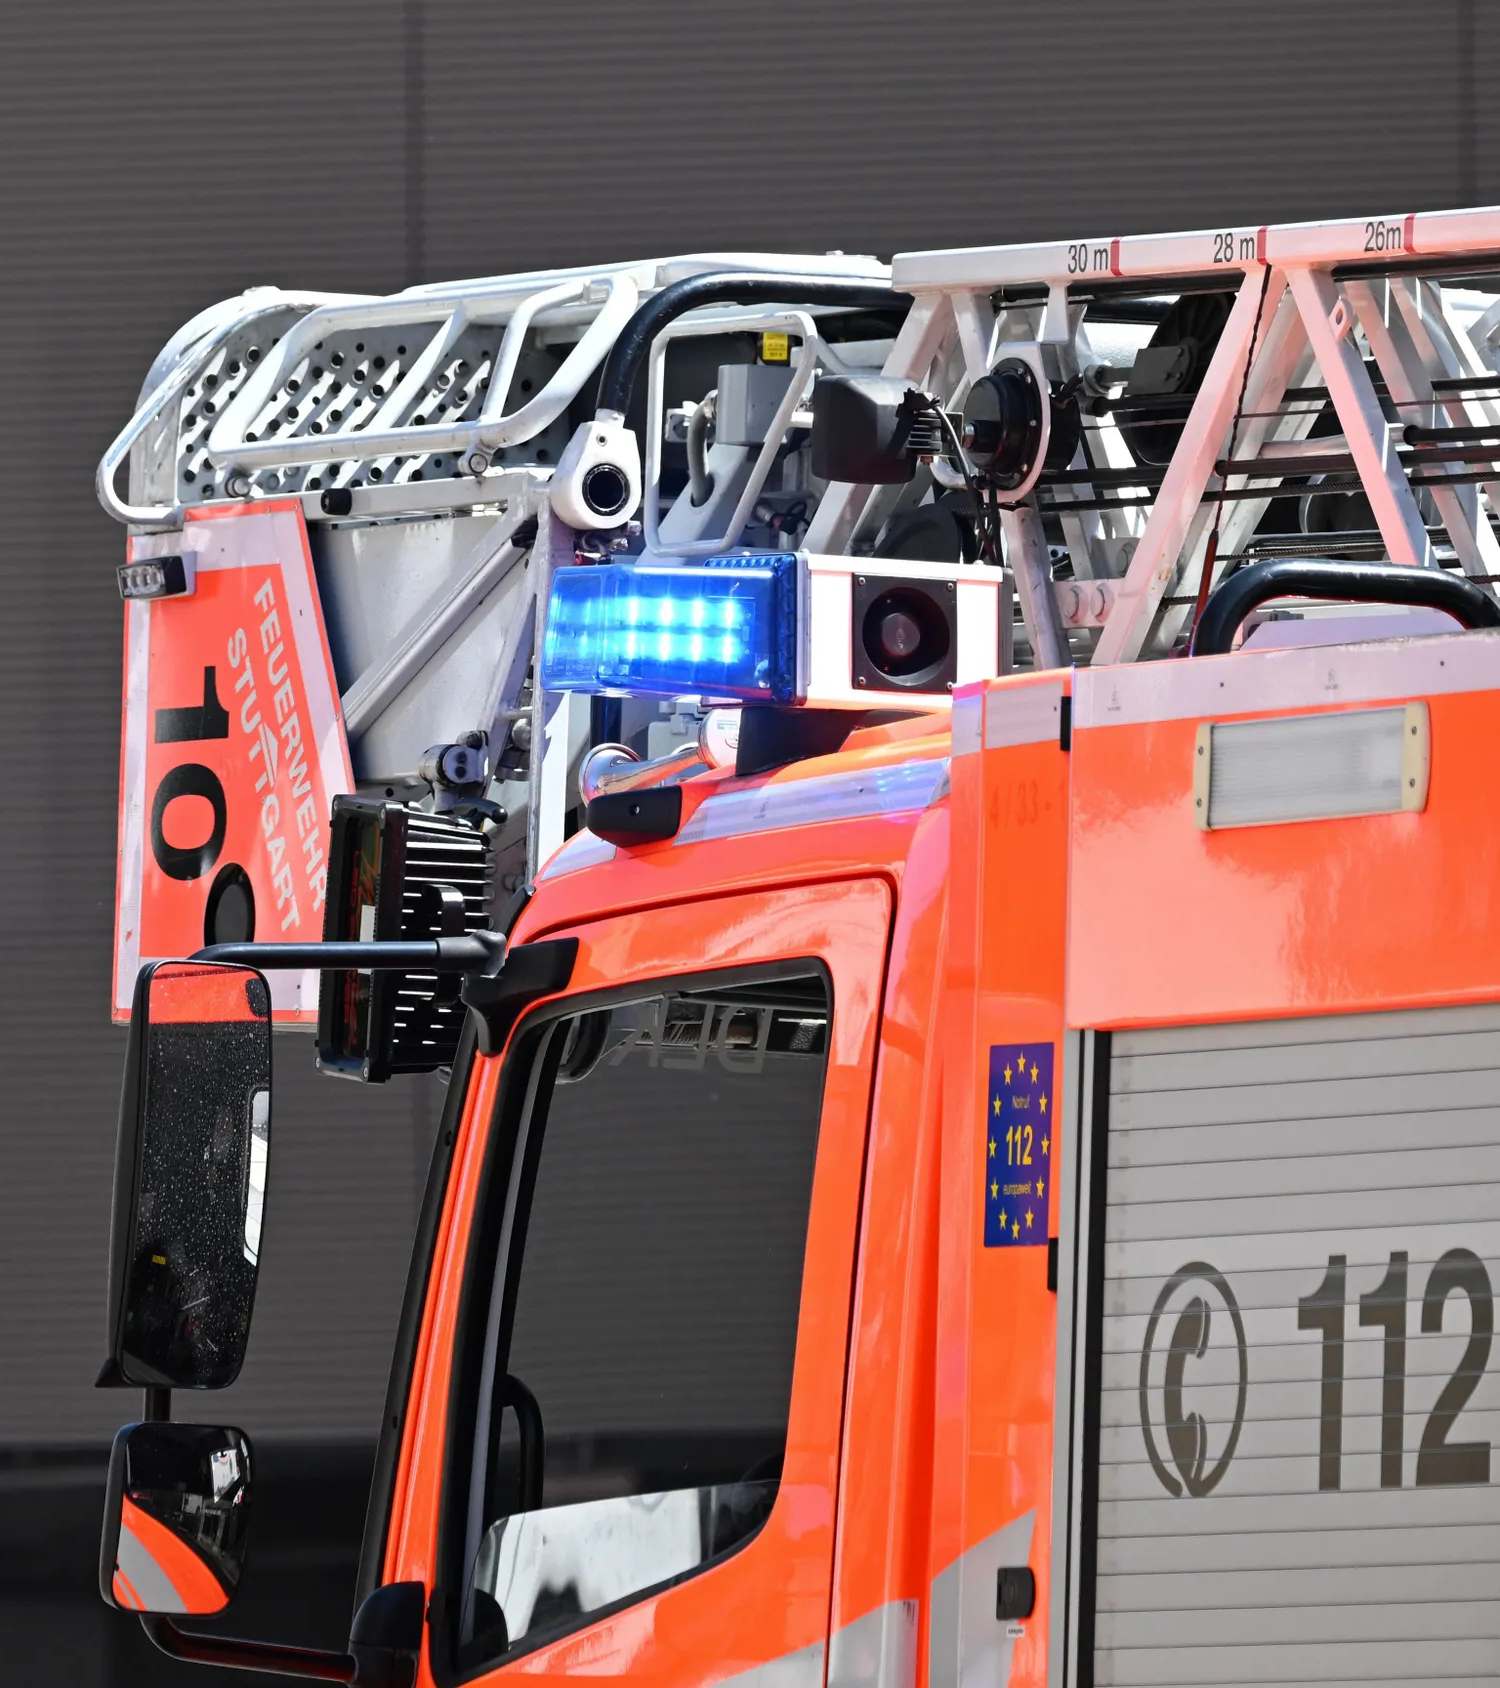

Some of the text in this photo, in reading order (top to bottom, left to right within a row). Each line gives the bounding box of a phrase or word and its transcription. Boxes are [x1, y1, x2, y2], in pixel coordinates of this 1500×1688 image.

[1213, 233, 1255, 263] 28 m
[1364, 221, 1402, 252] 26m
[1067, 243, 1109, 274] 30 m
[254, 577, 327, 912] FEUERWEHR
[151, 665, 230, 881] 10
[227, 627, 300, 932] STUTTGART
[1012, 1094, 1030, 1109] Notruf
[1006, 1124, 1033, 1166] 112
[1003, 1181, 1032, 1197] europaweit
[1298, 1247, 1494, 1491] 112
